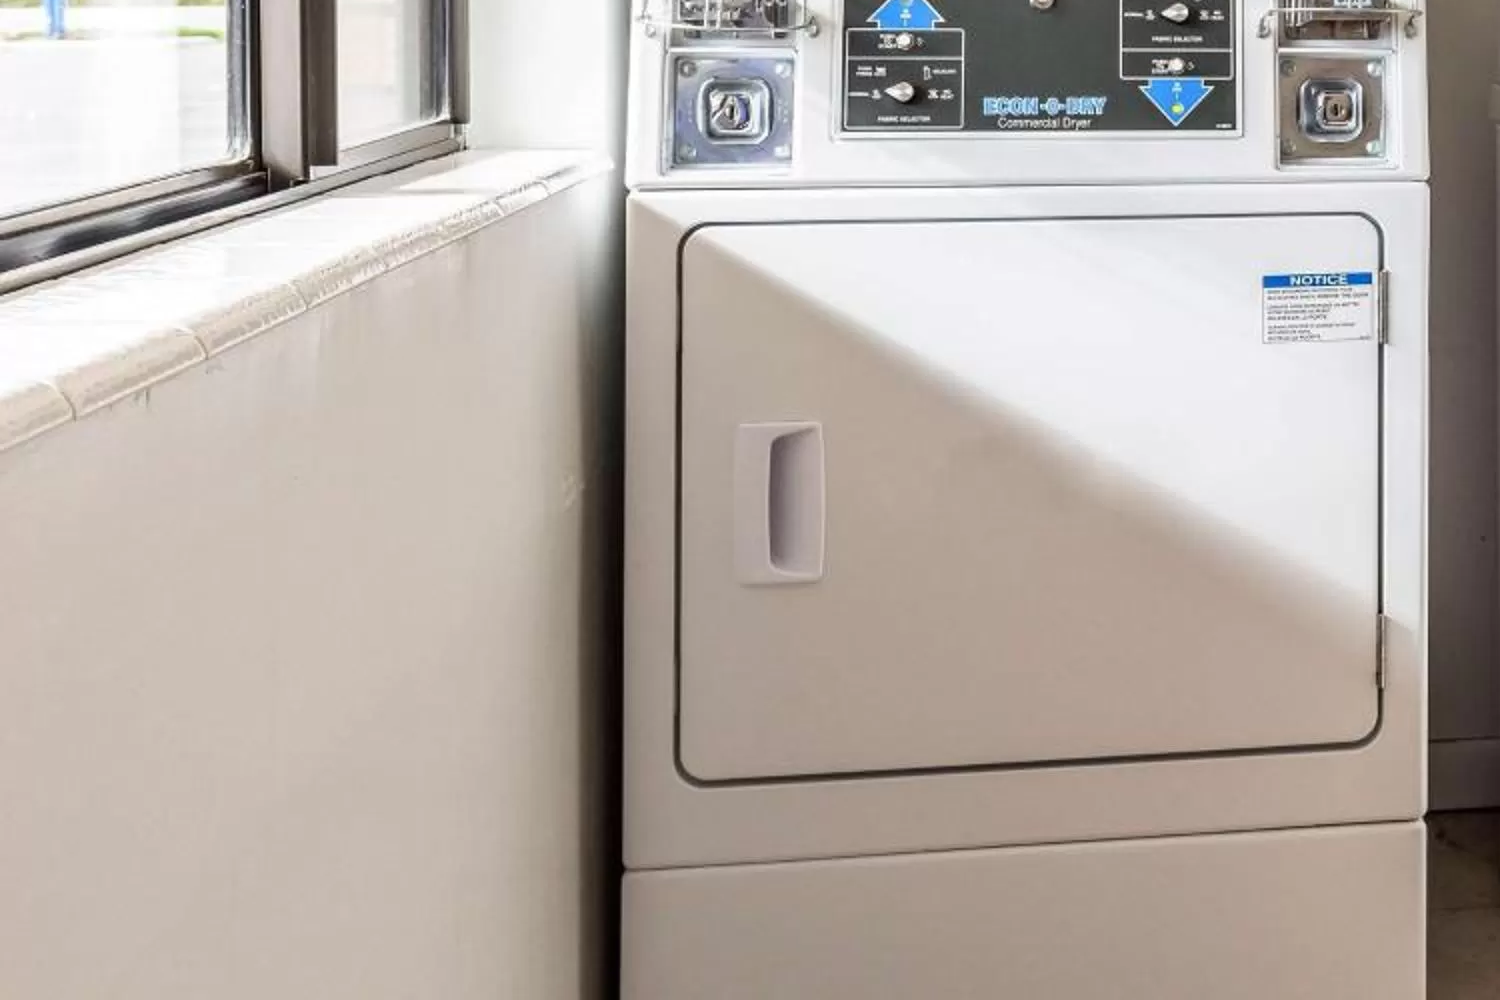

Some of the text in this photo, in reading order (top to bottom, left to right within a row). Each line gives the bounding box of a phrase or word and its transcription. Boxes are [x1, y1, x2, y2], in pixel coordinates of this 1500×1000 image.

[997, 116, 1092, 131] Commercial Dryer
[1289, 274, 1348, 287] NOTICE
